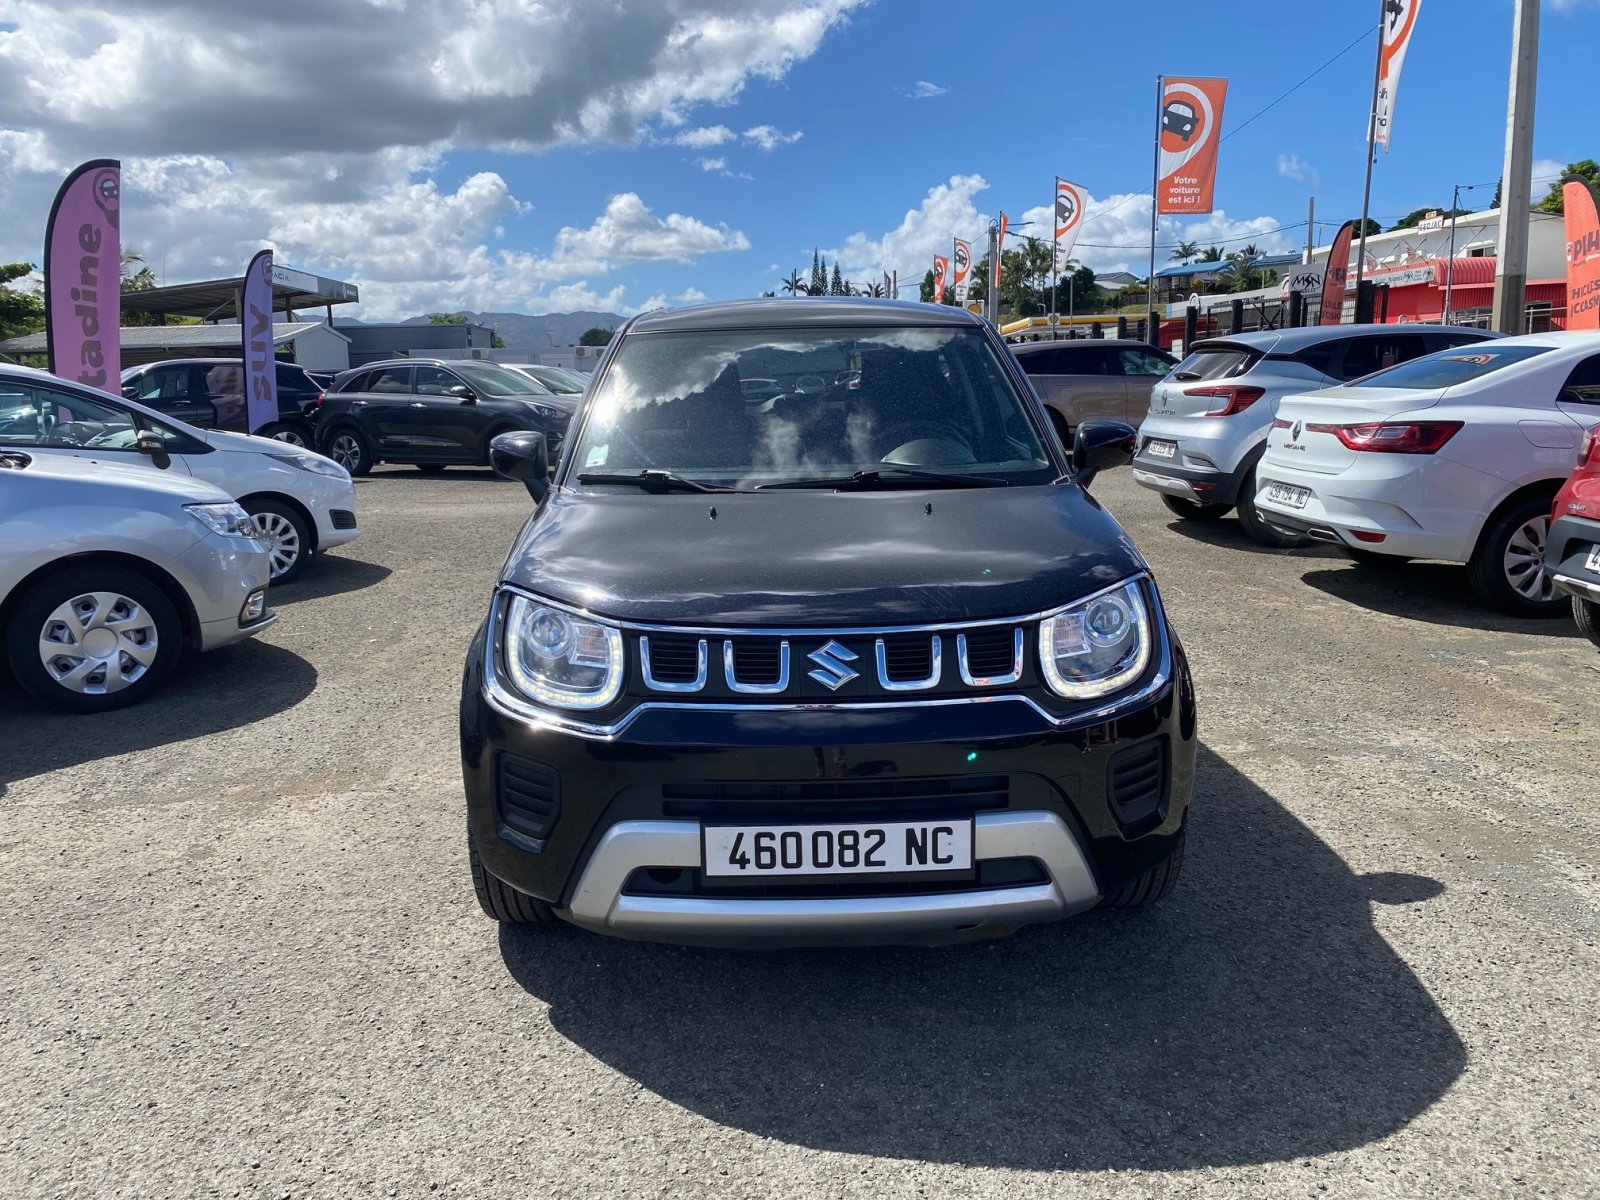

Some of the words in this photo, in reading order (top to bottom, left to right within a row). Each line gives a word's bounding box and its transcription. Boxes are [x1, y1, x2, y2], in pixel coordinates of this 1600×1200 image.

[1174, 176, 1198, 184] Votre
[1169, 186, 1201, 194] voiture
[1168, 196, 1182, 204] est
[1183, 195, 1195, 204] ici
[272, 270, 290, 282] ACIA
[905, 826, 953, 866] NC
